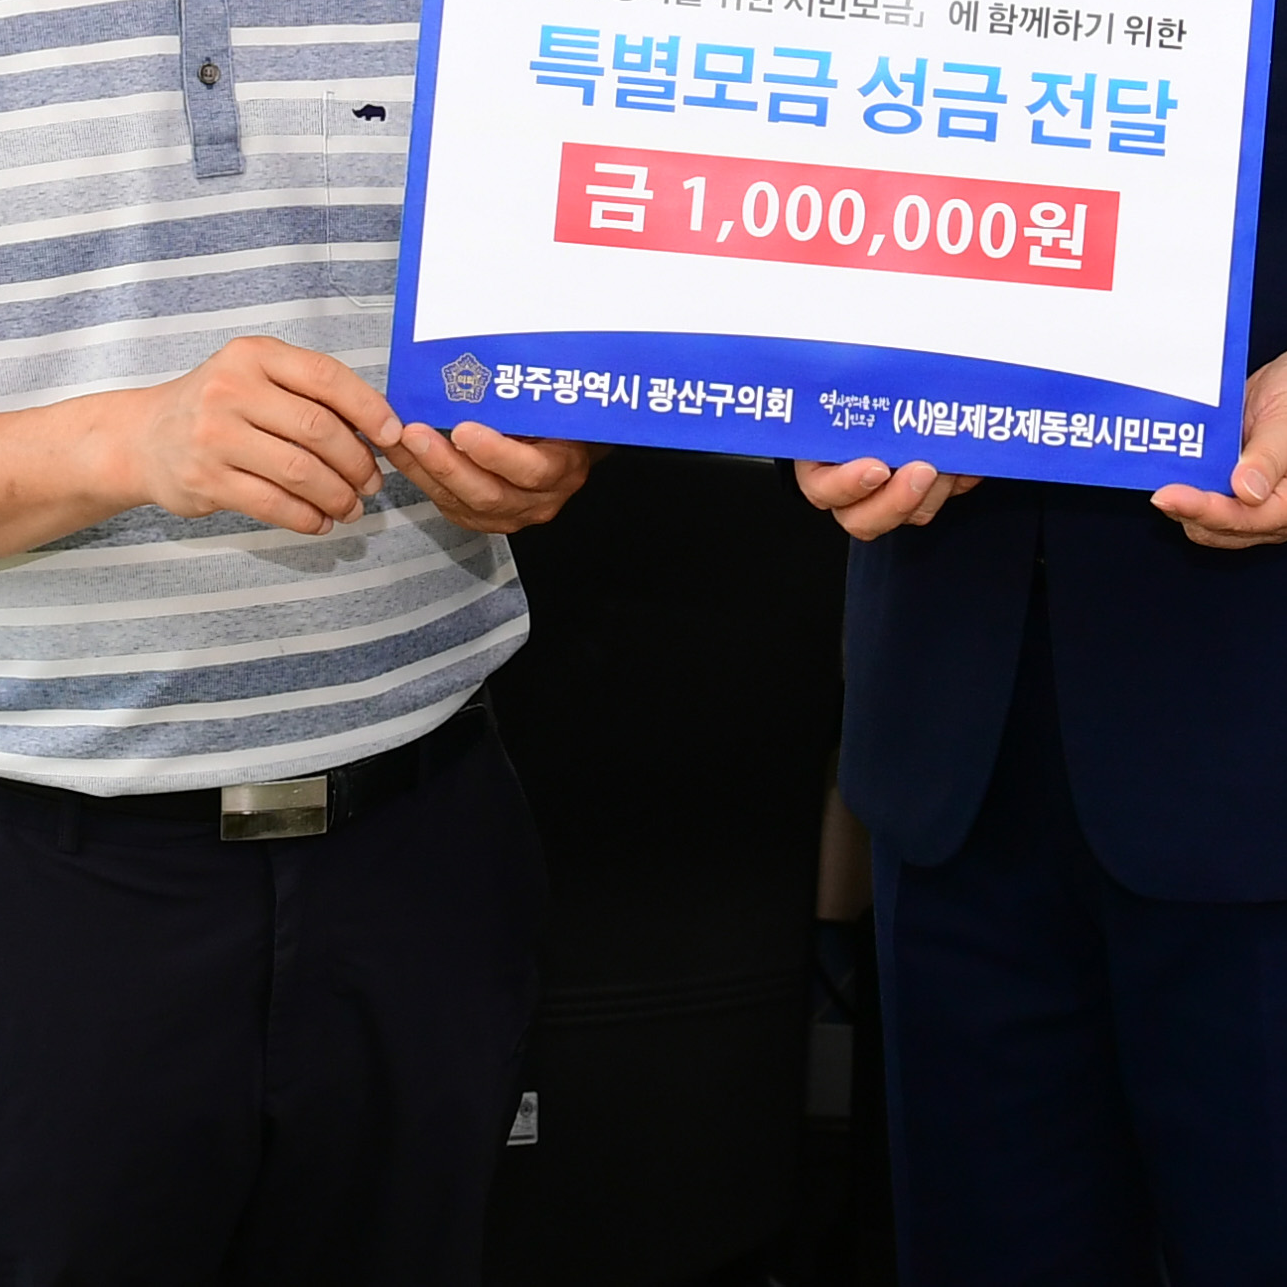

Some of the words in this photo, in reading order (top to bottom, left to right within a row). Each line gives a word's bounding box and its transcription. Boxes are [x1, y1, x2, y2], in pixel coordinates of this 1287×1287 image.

[947, 0, 981, 33] 에
[987, 1, 1116, 45] 함께하기
[1122, 14, 1189, 52] 위한
[528, 23, 840, 129] 특별모금
[857, 55, 1009, 144] 성금
[1025, 70, 1180, 158] 전달
[584, 161, 655, 234] 금
[681, 175, 1089, 271] 1,000,000원
[493, 364, 642, 410] 광주광역시
[647, 377, 795, 423] 광산구의회
[892, 398, 1207, 460] (사)일제강제동원시민모임
